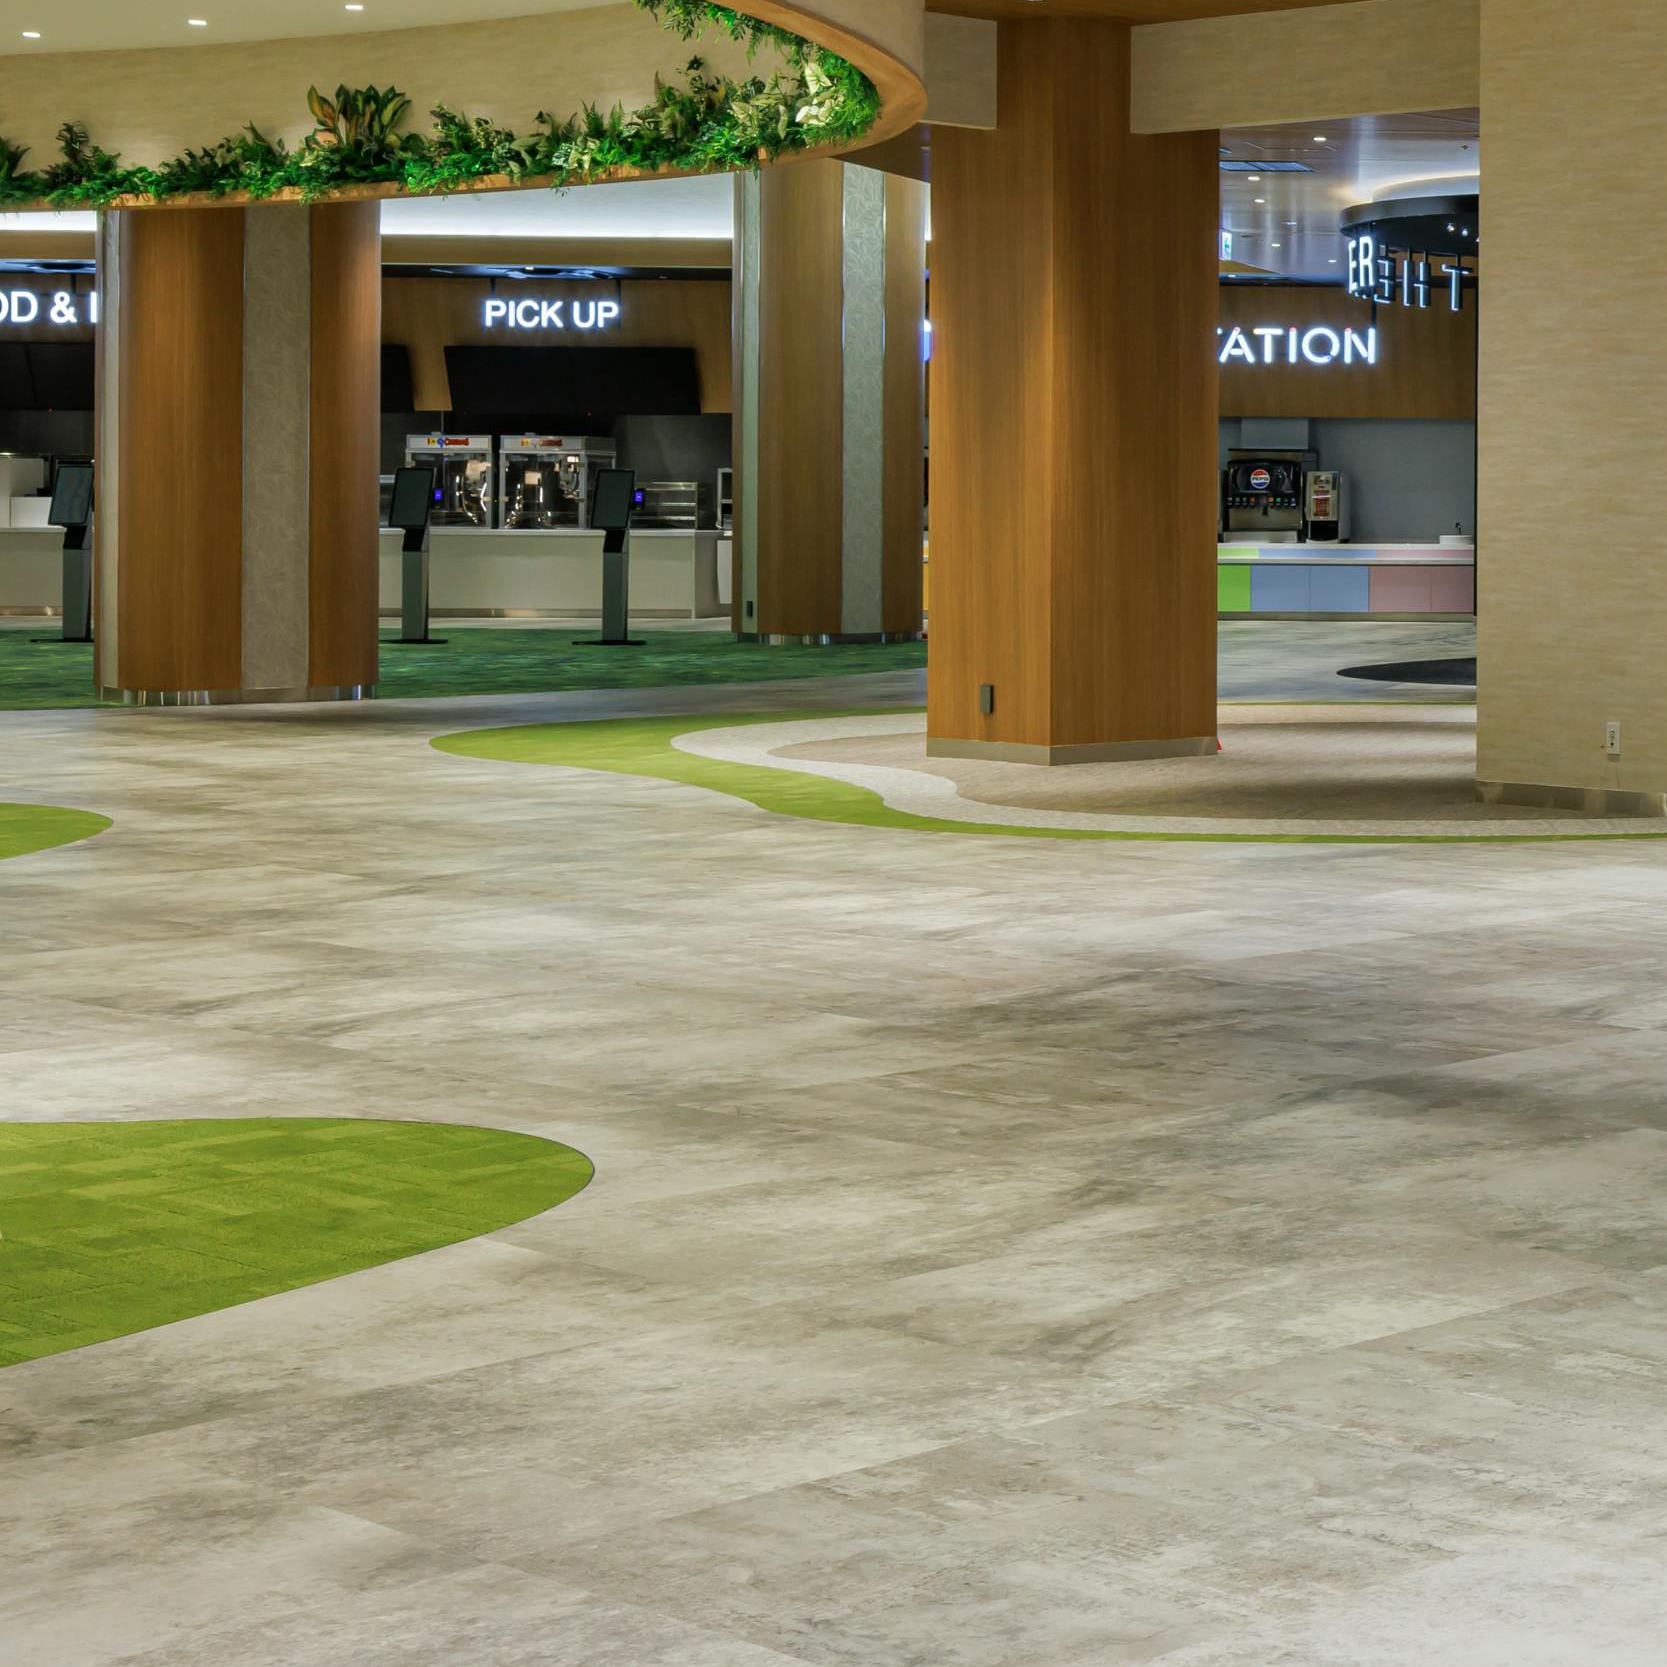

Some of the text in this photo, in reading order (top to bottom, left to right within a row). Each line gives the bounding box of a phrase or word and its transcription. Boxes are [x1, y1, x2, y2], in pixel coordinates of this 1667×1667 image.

[50, 291, 78, 324] &
[485, 300, 619, 328] PICK UP
[1217, 327, 1376, 363] ATION
